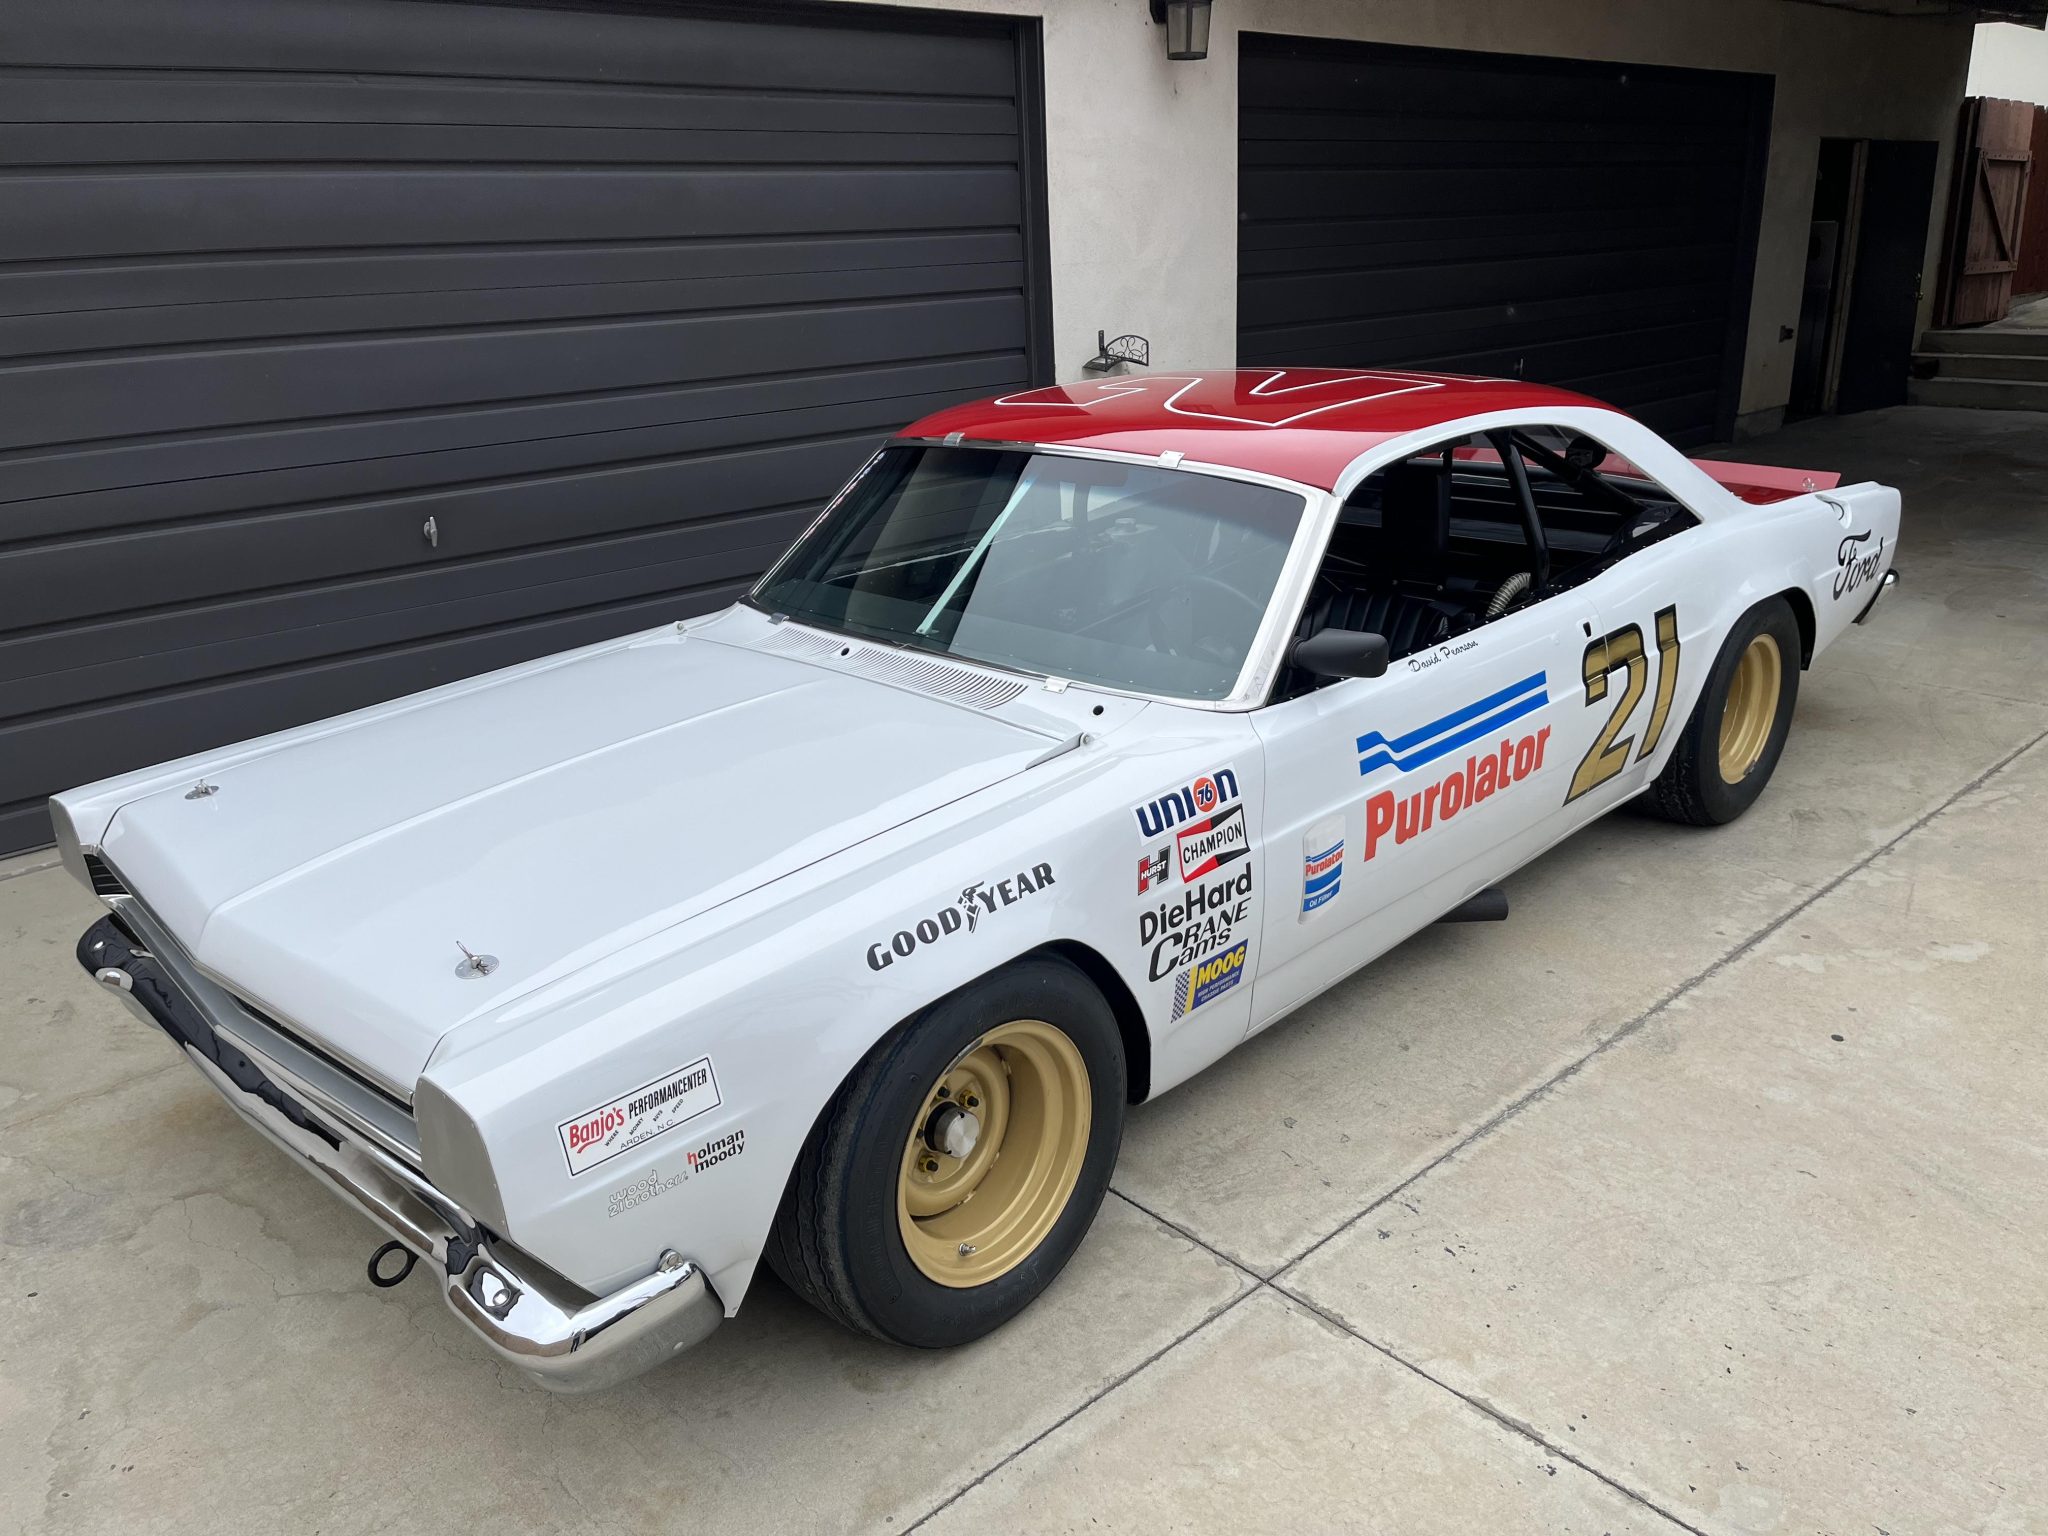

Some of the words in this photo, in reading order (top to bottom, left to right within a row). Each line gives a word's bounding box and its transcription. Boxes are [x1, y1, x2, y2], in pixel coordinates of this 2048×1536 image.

[1833, 529, 1884, 601] Ford
[1408, 652, 1442, 673] David
[1440, 640, 1479, 659] Pearson
[1562, 603, 1681, 808] 21
[1197, 782, 1214, 806] 76
[1364, 724, 1551, 863] Purolator
[1182, 821, 1243, 864] CHAMPION
[1305, 848, 1345, 877] Purolator
[1140, 860, 1168, 880] HURST
[1139, 861, 1252, 948] DieHard
[1196, 945, 1246, 989] MOOG
[569, 1107, 625, 1154] Banjo's
[628, 1067, 708, 1120] PERFORMANCENTER
[604, 1129, 620, 1147] WHERE
[629, 1116, 645, 1136] MONEY
[671, 1097, 684, 1114] SPEED
[687, 1129, 745, 1165] holman
[695, 1140, 746, 1174] moody
[608, 1168, 658, 1203] wood
